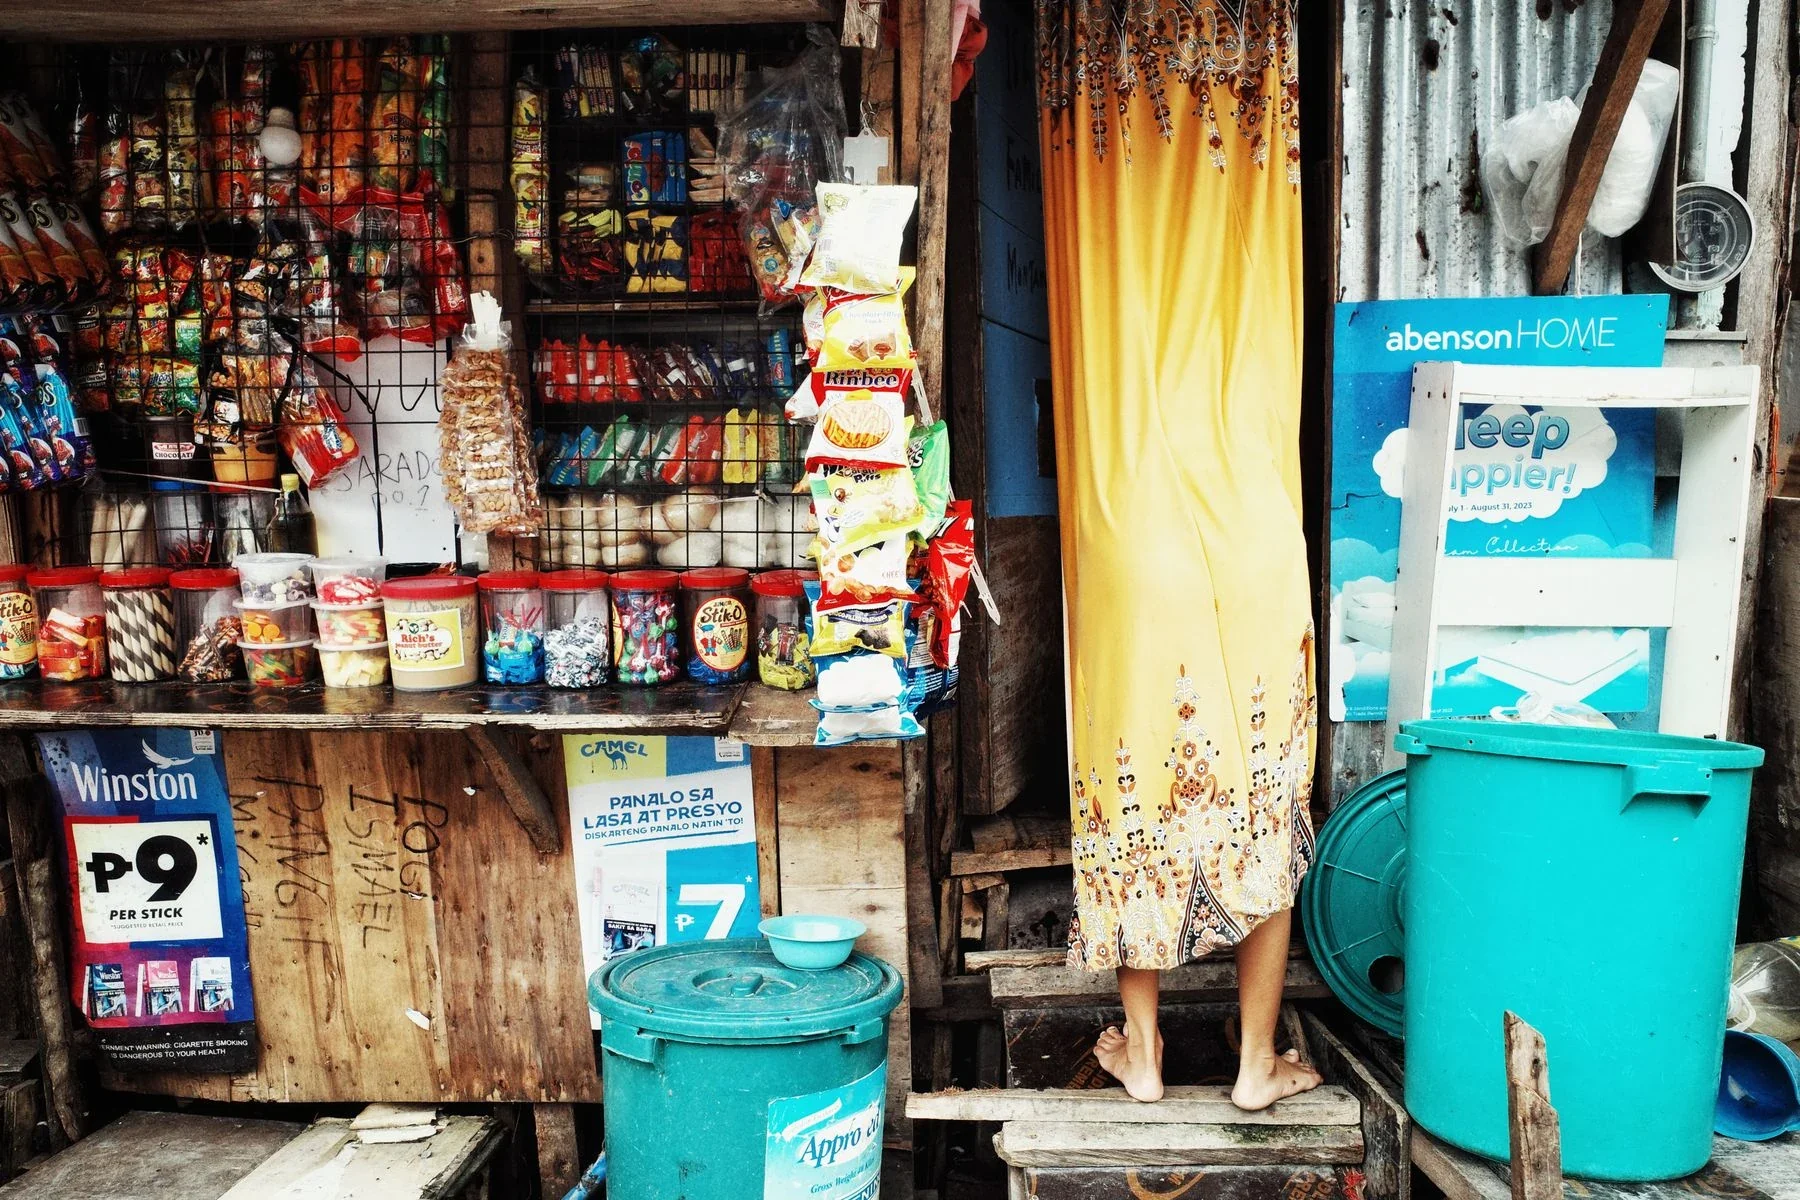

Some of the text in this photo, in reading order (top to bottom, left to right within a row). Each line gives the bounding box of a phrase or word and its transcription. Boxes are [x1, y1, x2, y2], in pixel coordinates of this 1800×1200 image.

[1455, 403, 1570, 459] leep
[1450, 454, 1577, 496] ppier!
[1471, 504, 1500, 513] August
[1501, 503, 1513, 511] 31,
[1513, 502, 1533, 510] 2023
[1485, 536, 1578, 554] Collection
[0, 598, 33, 617] tik-O
[700, 605, 742, 623] Stik-O
[395, 642, 417, 650] peanut
[401, 634, 435, 642] Rich's
[580, 740, 648, 757] CAMEL
[70, 761, 198, 802] Winston
[609, 787, 714, 810] PANALO SA
[583, 801, 743, 830] LASA AT PRESYO
[585, 827, 648, 840] DISKARTENG
[650, 822, 690, 833] PANALO
[692, 819, 723, 829] NATIN
[344, 784, 399, 948] ISMAEL
[109, 907, 183, 920] PER STICK
[101, 1039, 249, 1052] ERNMENT WARNING: CIGARETTE SMOKING
[119, 1052, 163, 1060] DANGEROUS
[176, 1050, 197, 1058] YOUR
[198, 1048, 226, 1056] HEALTH
[810, 1182, 833, 1194] Gross
